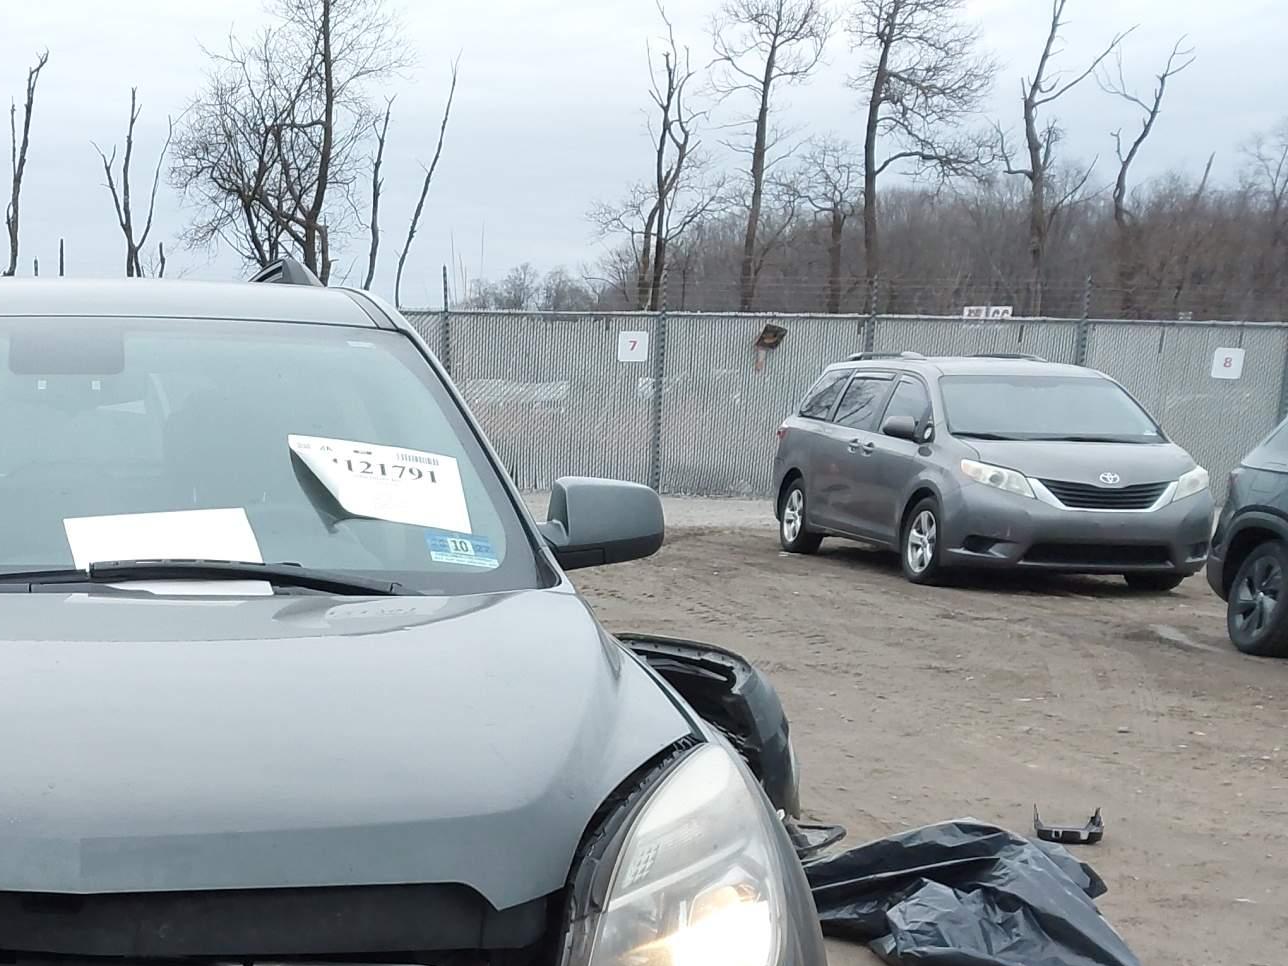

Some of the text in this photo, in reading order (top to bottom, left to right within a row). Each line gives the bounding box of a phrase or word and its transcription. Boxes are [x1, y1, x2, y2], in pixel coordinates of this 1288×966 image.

[628, 340, 638, 351] 7
[1223, 356, 1233, 368] 8
[332, 457, 439, 484] 121791
[451, 539, 469, 553] 10
